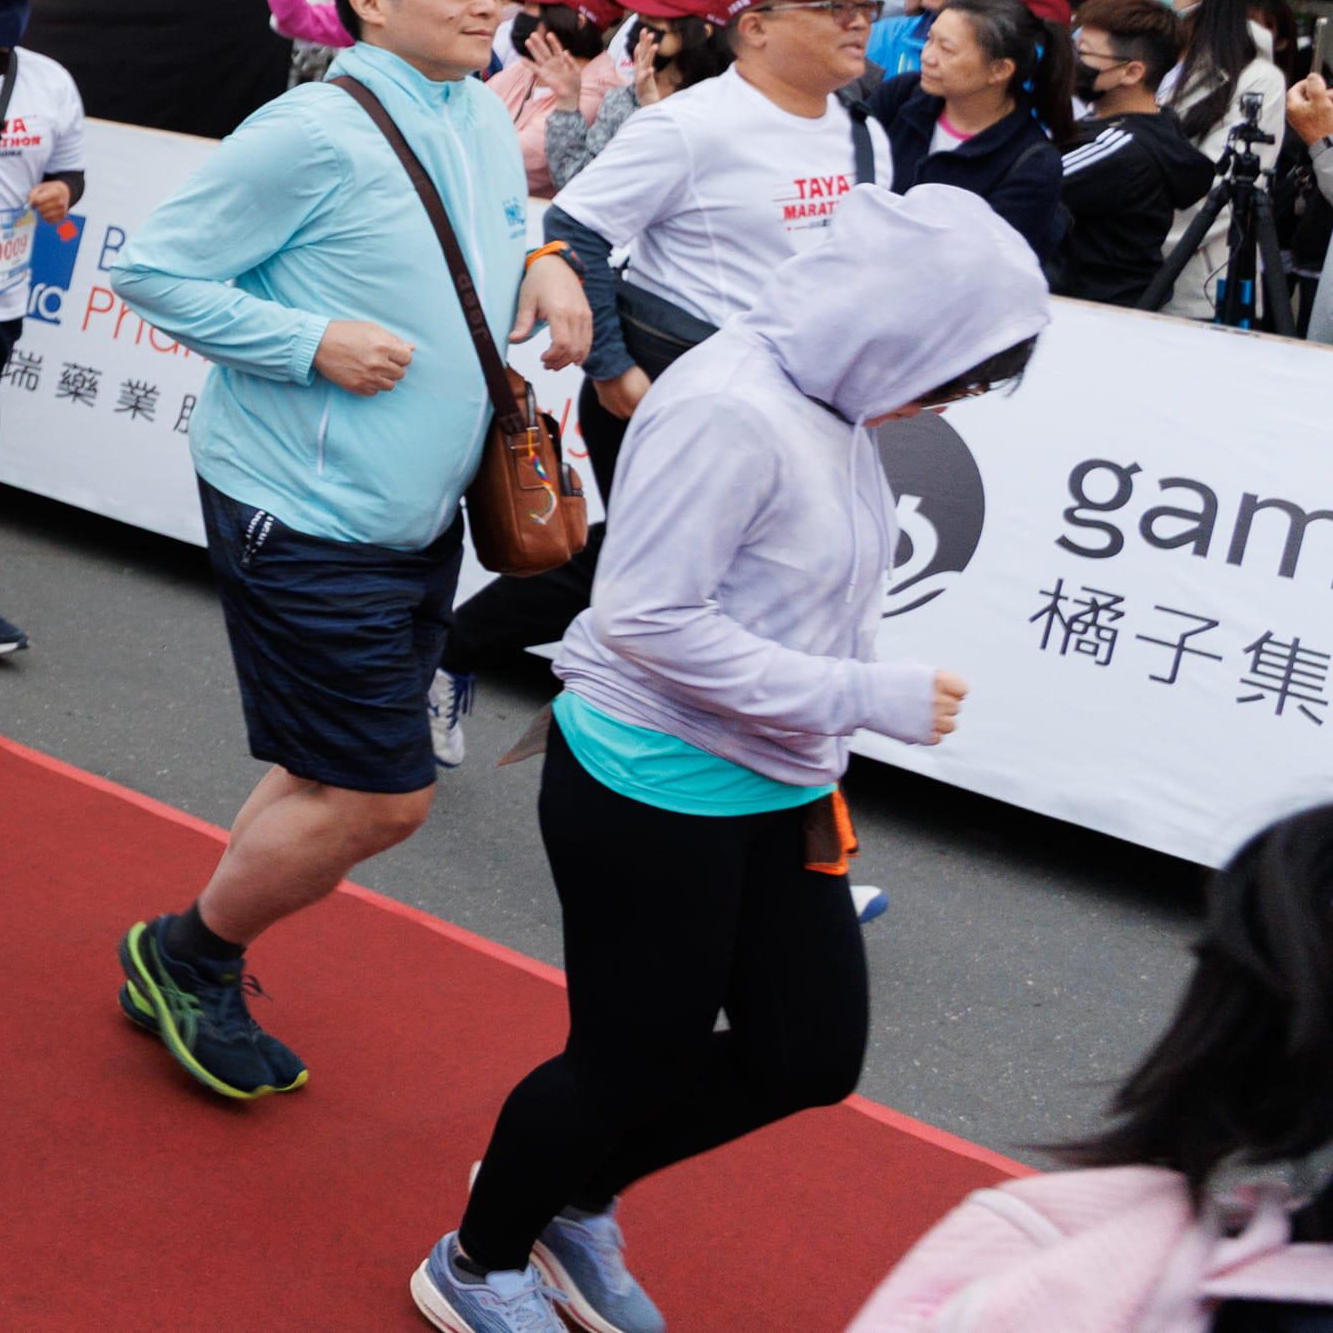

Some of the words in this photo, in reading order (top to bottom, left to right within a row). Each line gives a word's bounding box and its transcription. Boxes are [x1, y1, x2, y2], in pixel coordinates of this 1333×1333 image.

[794, 175, 851, 200] TAYA
[1029, 577, 1333, 727] 橘子集
